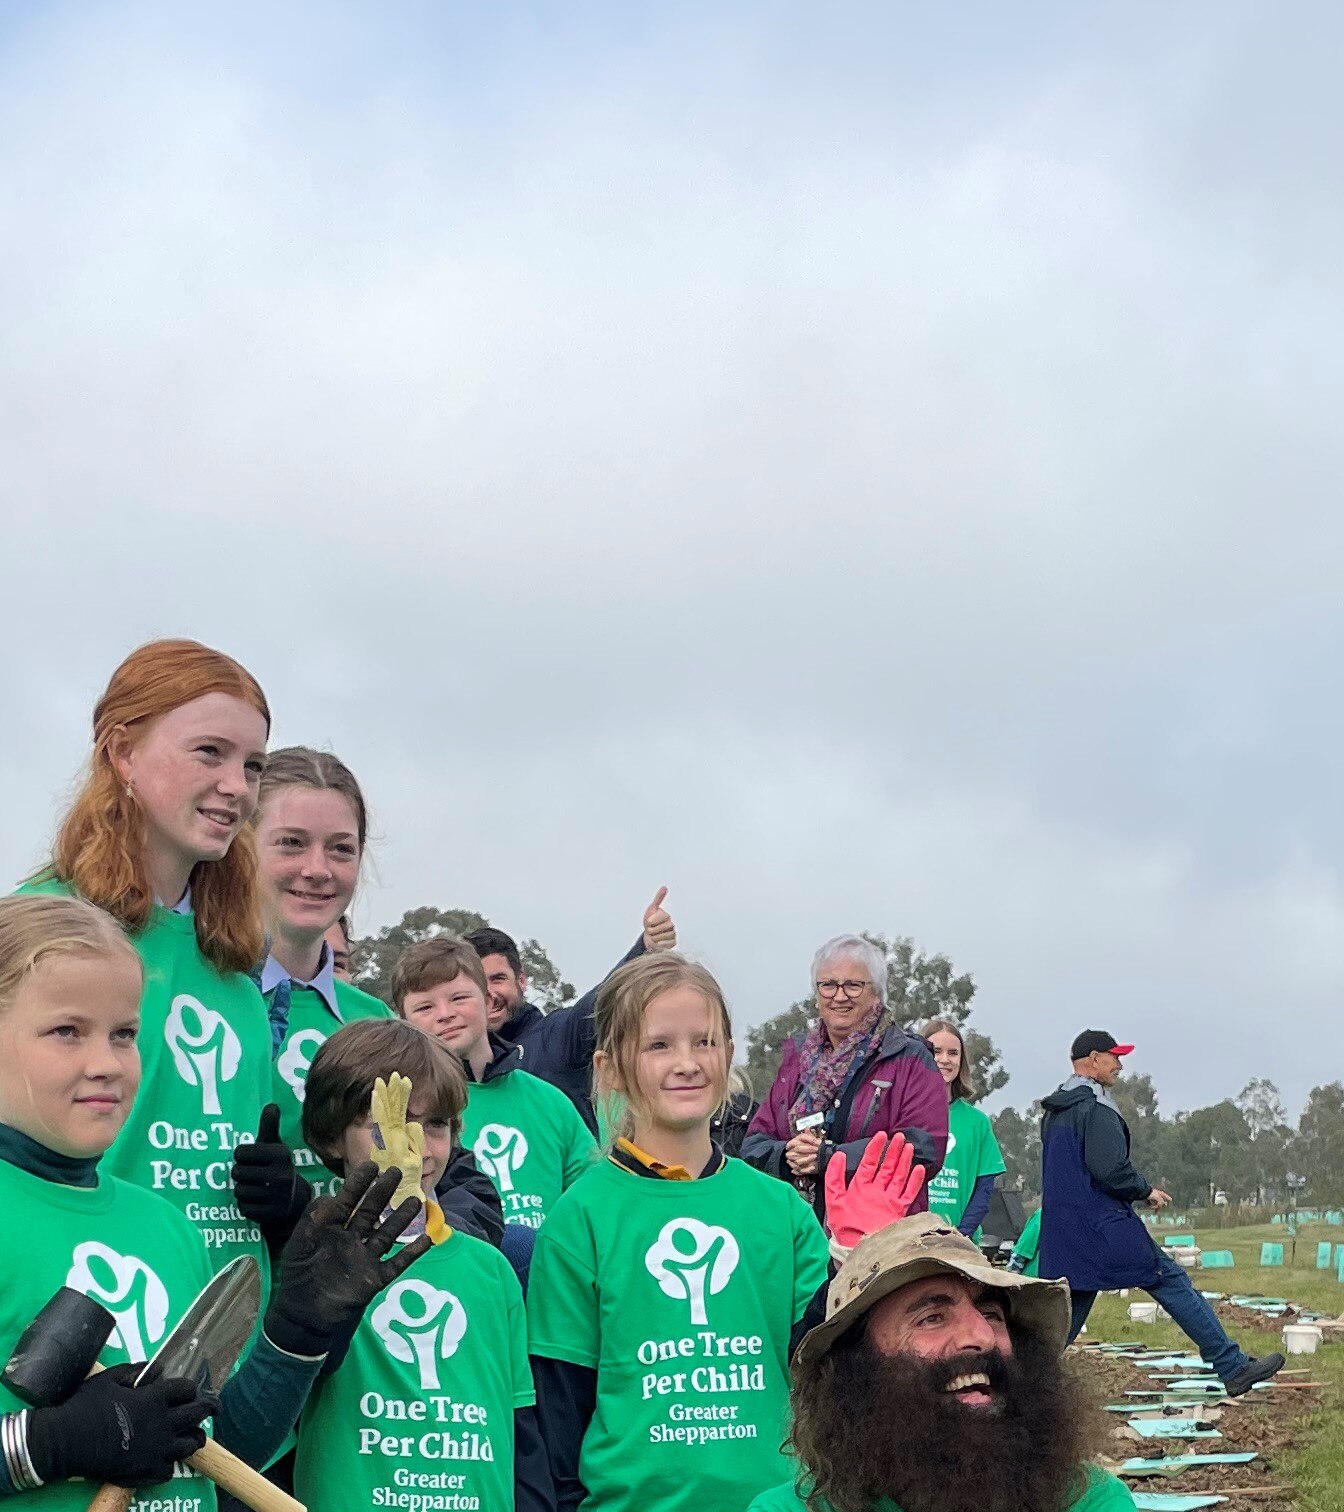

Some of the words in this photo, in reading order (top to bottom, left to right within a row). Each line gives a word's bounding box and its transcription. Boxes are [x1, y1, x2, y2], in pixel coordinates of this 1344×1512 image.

[148, 1121, 208, 1150] One
[211, 1123, 256, 1150] Tre
[150, 1160, 201, 1190] Per
[186, 1203, 246, 1221] Great
[201, 1227, 262, 1248] pparto
[637, 1338, 695, 1365] One
[697, 1332, 763, 1356] Tree
[641, 1373, 687, 1400] Per
[691, 1363, 766, 1393] Child
[359, 1391, 427, 1421] One
[429, 1396, 488, 1426] Tree
[669, 1403, 739, 1421] Greater
[358, 1428, 415, 1457] Per
[418, 1431, 495, 1462] Child
[649, 1423, 758, 1446] Shepparton
[393, 1468, 467, 1490] Greater
